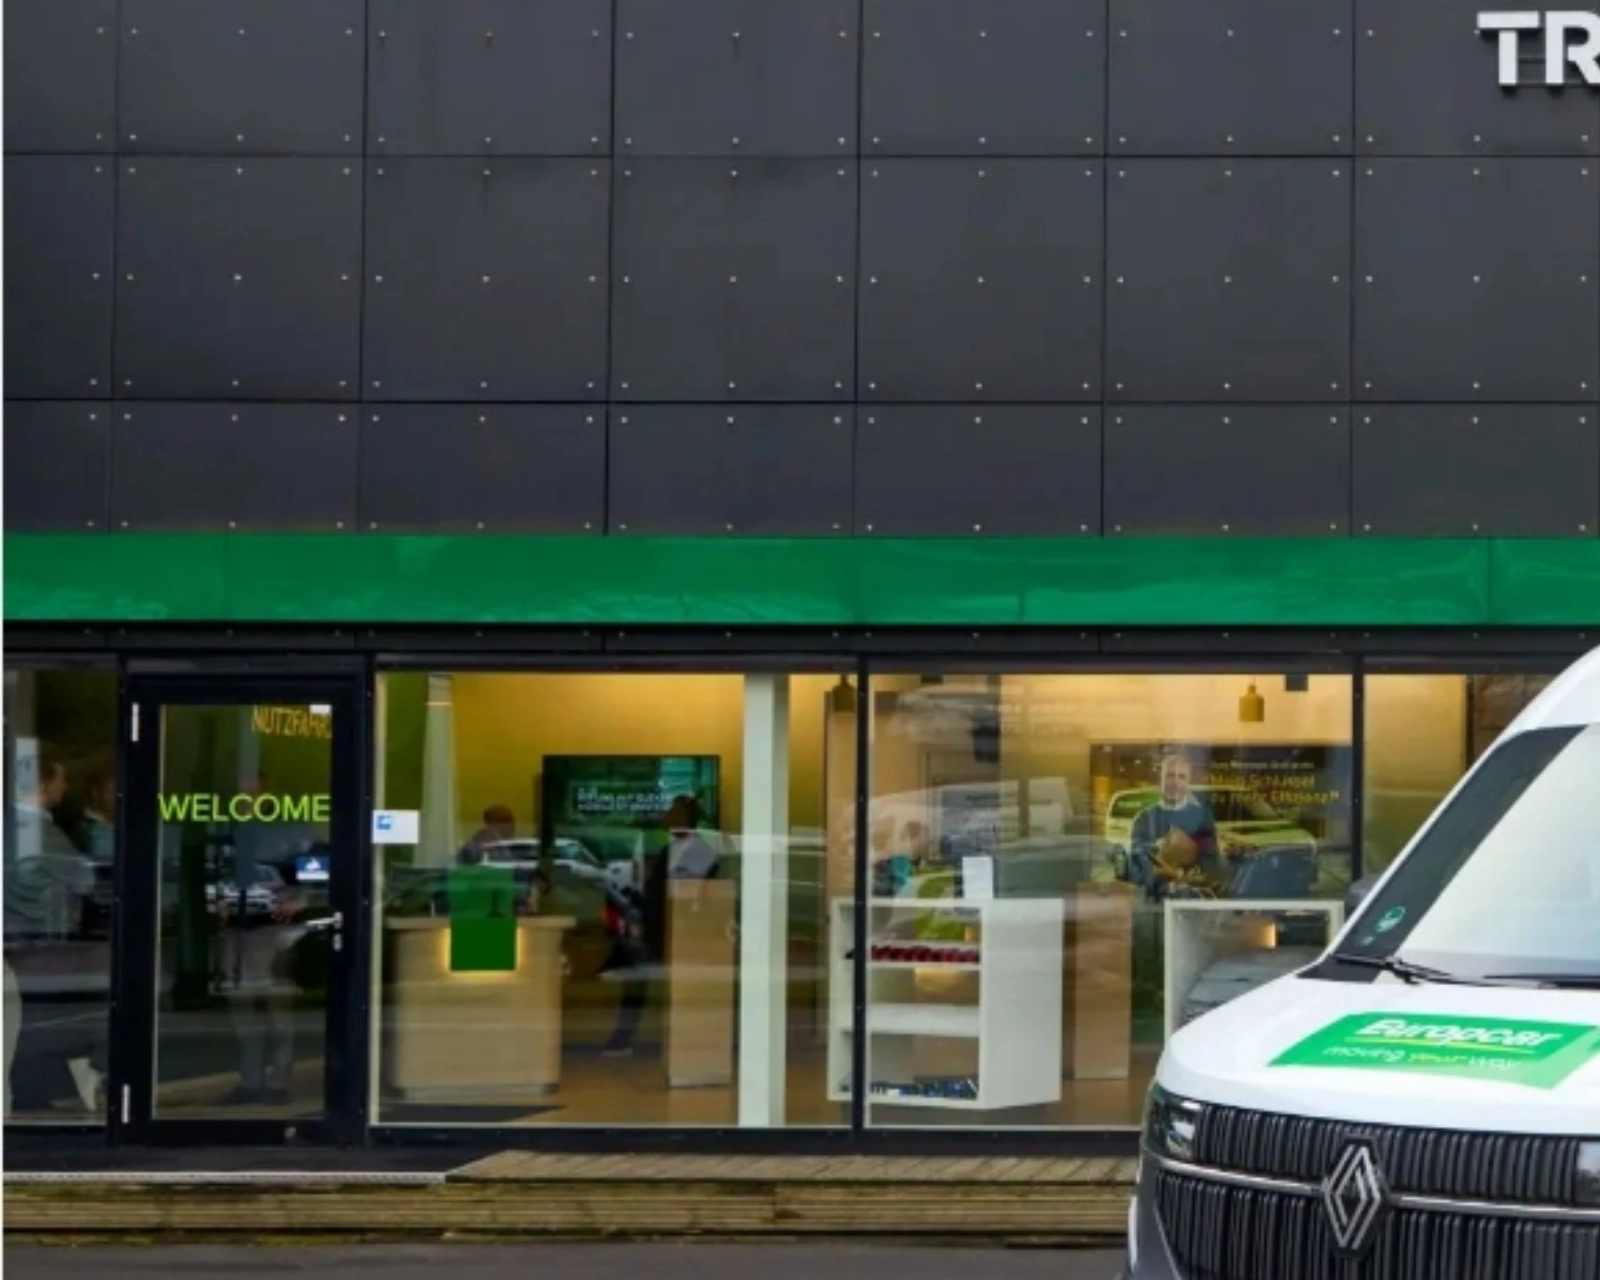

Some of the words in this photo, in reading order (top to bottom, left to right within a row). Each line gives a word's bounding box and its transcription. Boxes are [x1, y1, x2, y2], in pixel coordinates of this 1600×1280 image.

[157, 792, 332, 822] WELCOME
[1354, 1018, 1564, 1047] Europcar
[1321, 1045, 1405, 1063] moving
